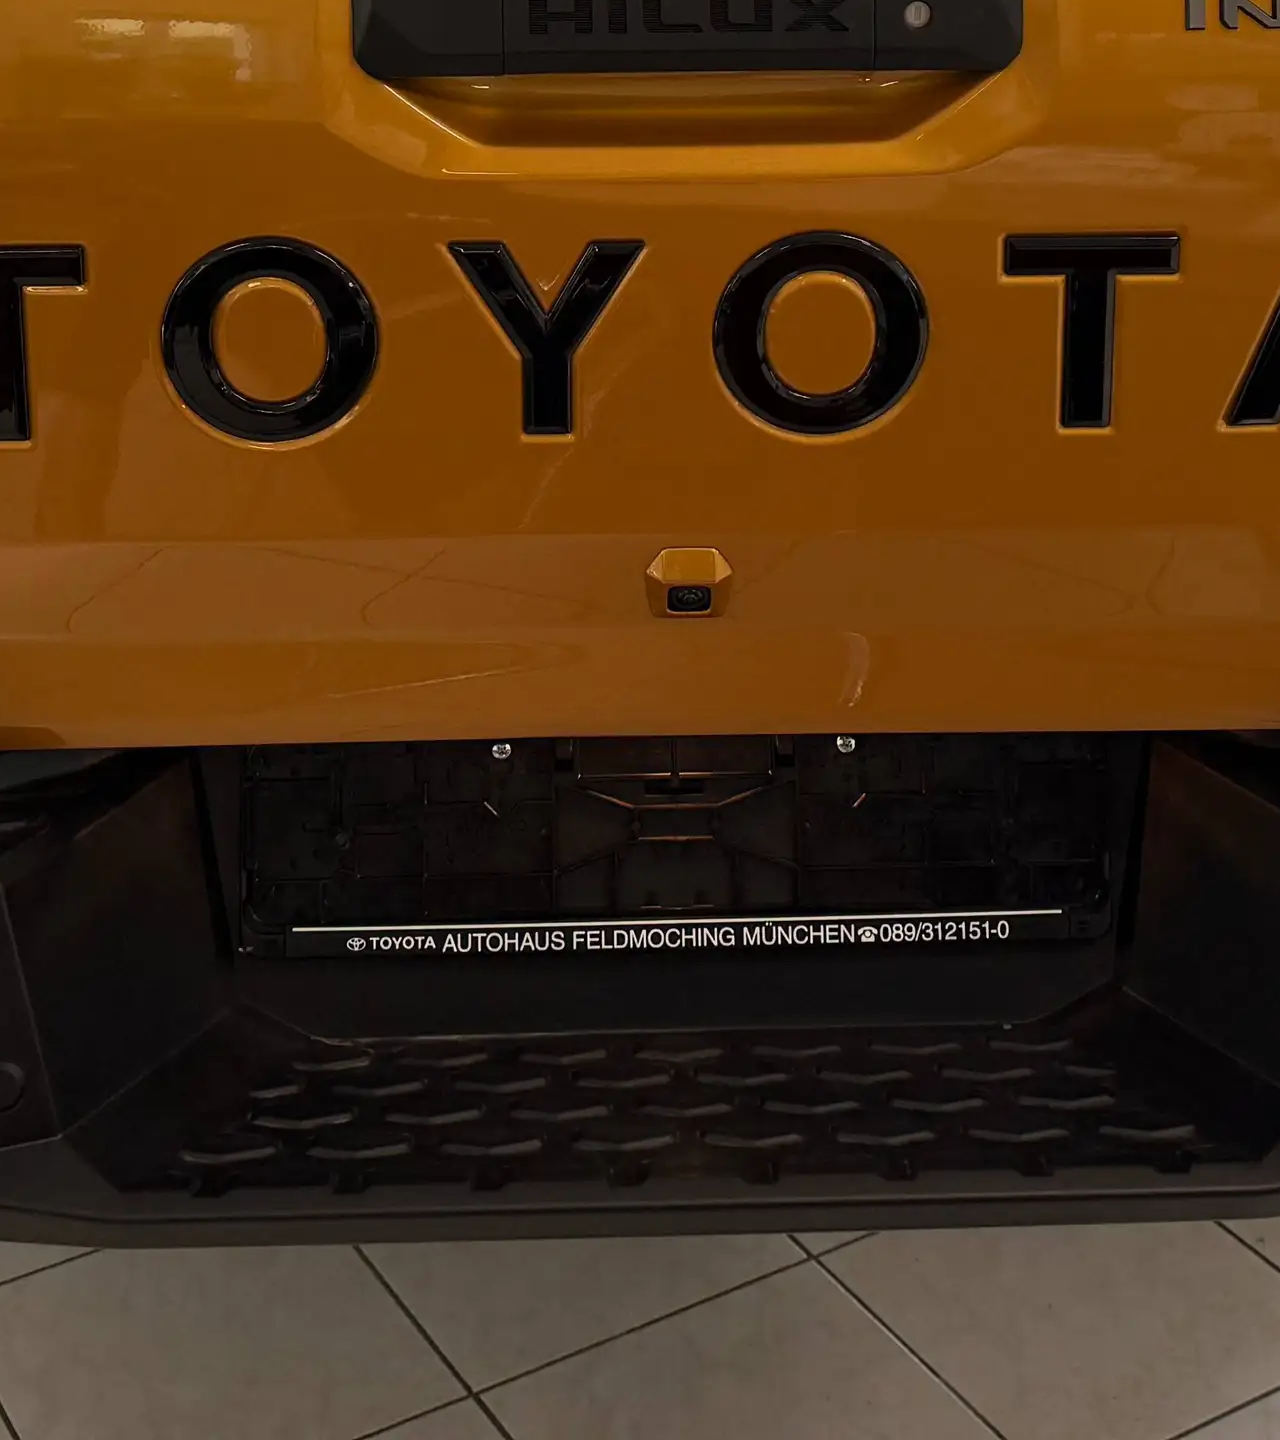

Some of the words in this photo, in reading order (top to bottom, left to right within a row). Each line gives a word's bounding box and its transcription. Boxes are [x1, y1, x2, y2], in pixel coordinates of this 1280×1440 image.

[370, 936, 436, 951] TOYOTA
[442, 931, 566, 953] AUTOHAUS
[572, 927, 736, 950] FELDMOCHING
[743, 921, 856, 946] MÜNCHEN
[879, 920, 1010, 941] 089/312151-0
